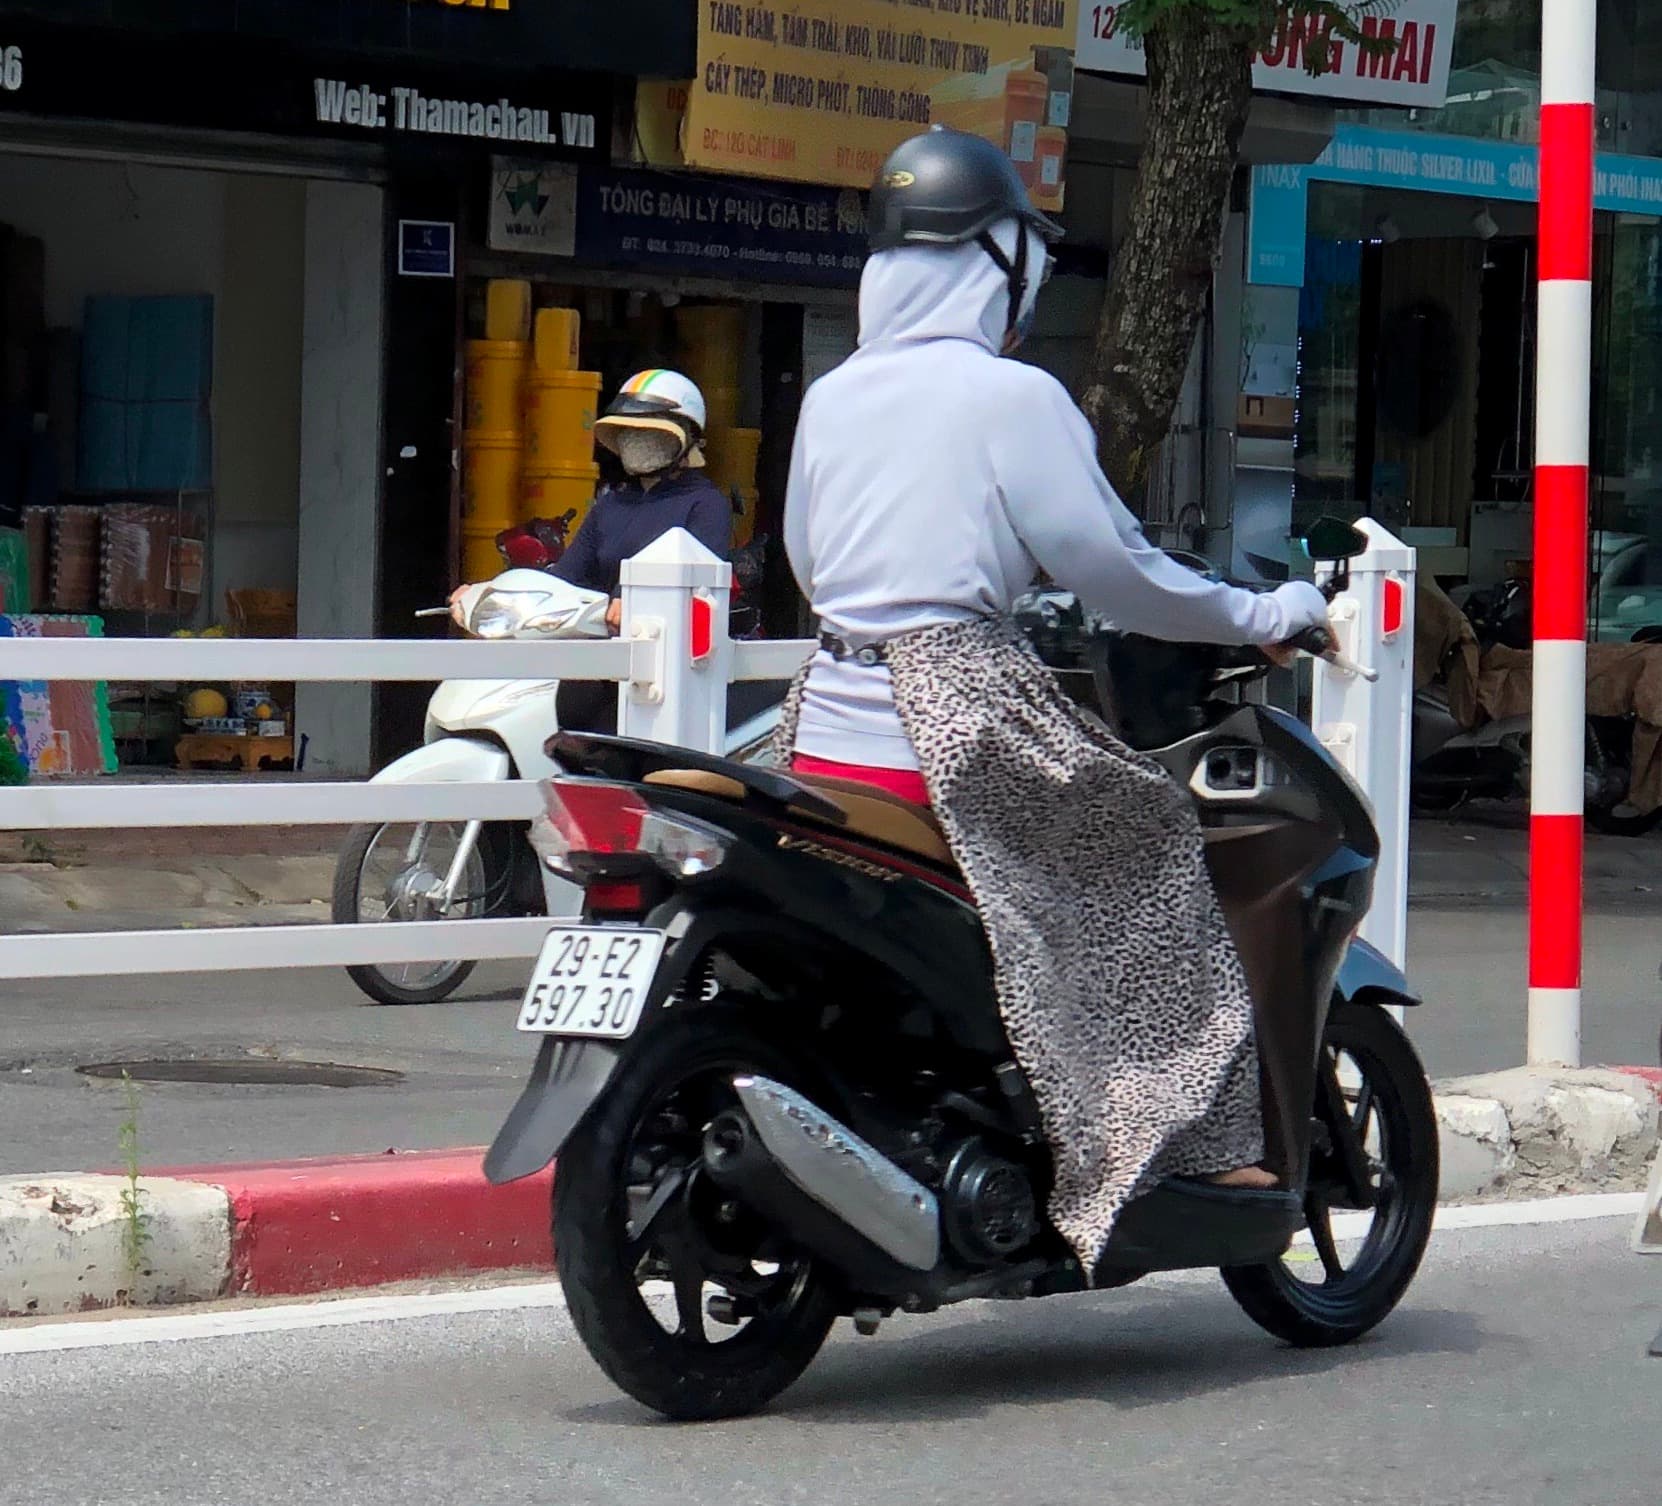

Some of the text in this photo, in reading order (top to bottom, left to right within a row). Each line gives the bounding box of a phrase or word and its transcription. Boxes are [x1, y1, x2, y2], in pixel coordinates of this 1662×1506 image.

[1356, 16, 1436, 84] MAI
[314, 78, 386, 128] Web:
[1421, 152, 1464, 181] SILVER
[658, 192, 691, 225] ĐẠI
[724, 197, 763, 230] PHỤ
[768, 202, 801, 231] GIA
[550, 934, 642, 980] 29-E2
[525, 983, 635, 1030] 597.30
